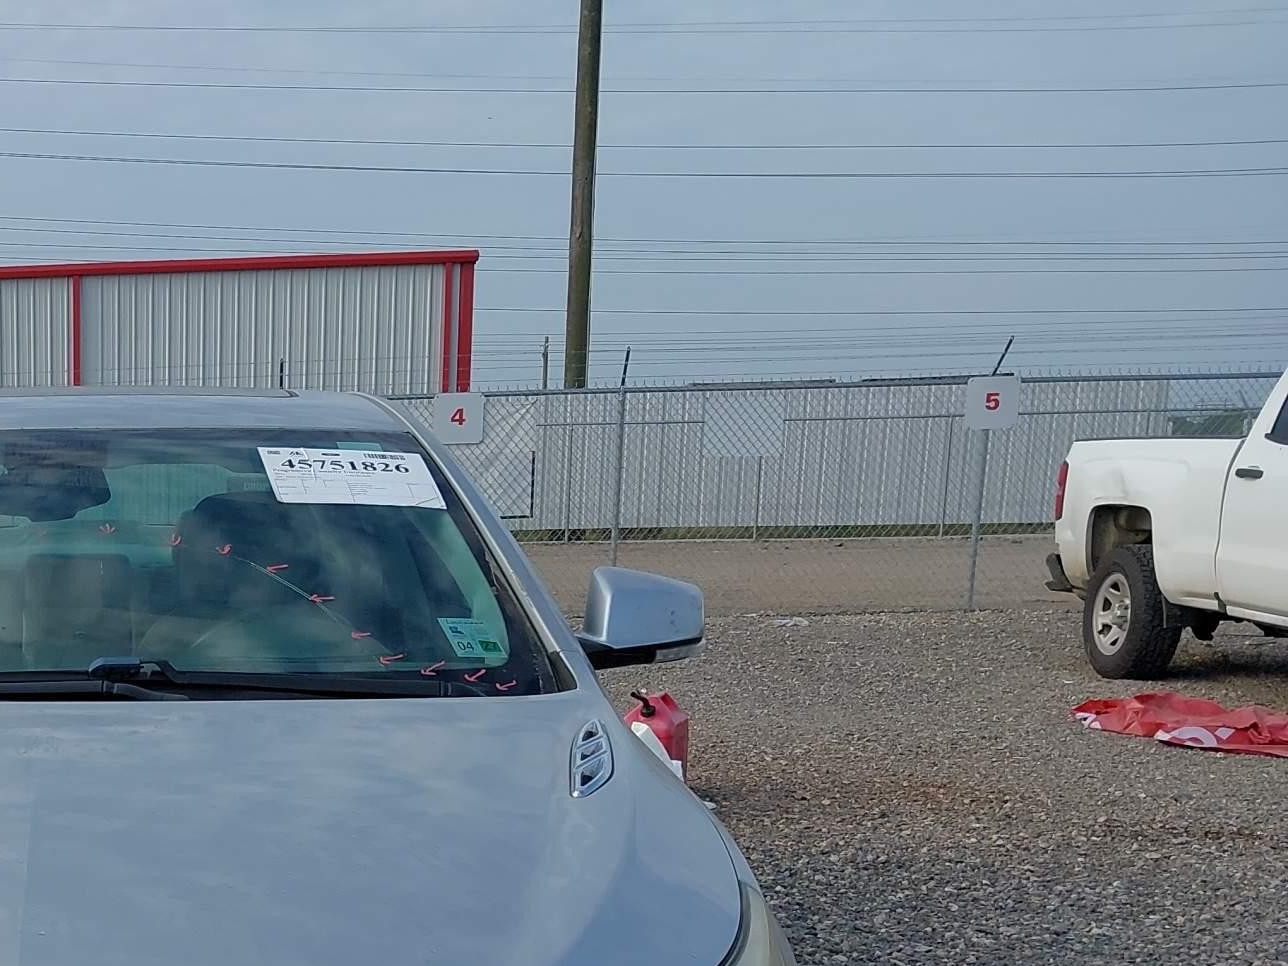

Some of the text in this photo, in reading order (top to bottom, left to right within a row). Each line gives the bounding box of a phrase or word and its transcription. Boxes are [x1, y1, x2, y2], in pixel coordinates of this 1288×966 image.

[984, 392, 1000, 411] 5
[450, 407, 466, 426] 4
[280, 458, 410, 474] 45751826
[457, 641, 474, 651] 04
